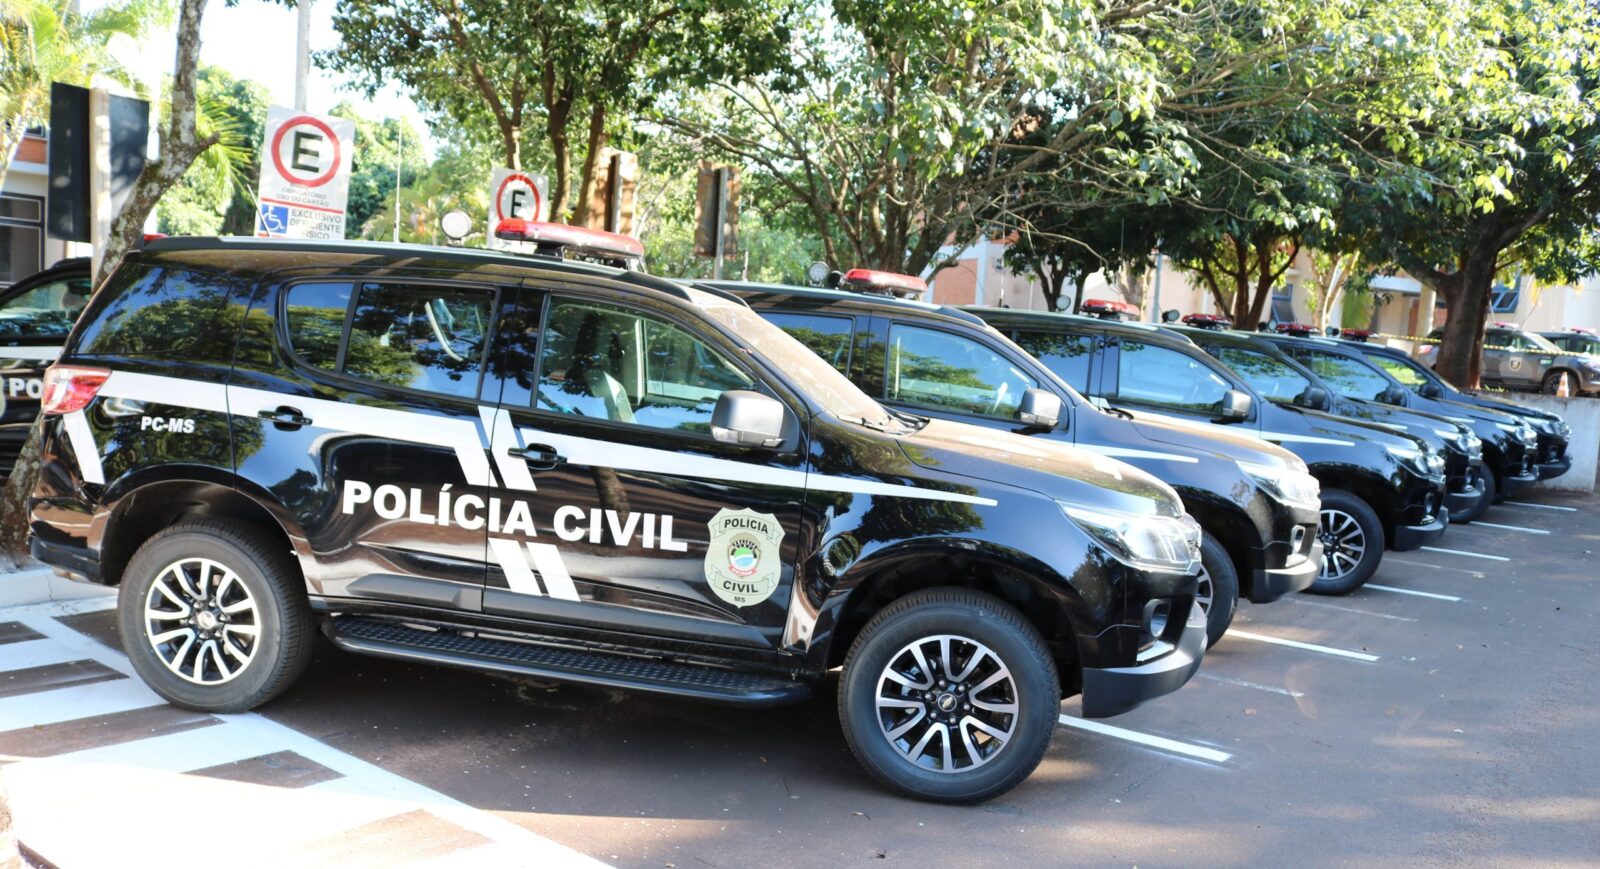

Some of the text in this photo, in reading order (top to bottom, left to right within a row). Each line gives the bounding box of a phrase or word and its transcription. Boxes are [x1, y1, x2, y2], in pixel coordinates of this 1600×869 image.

[291, 130, 323, 173] E
[292, 208, 342, 223] EXCLUSIVO
[290, 218, 341, 233] DEFCIENTE
[141, 416, 195, 433] PC-MS
[342, 480, 688, 552] POLÍCIA CIVIL
[723, 580, 759, 593] CIVIL
